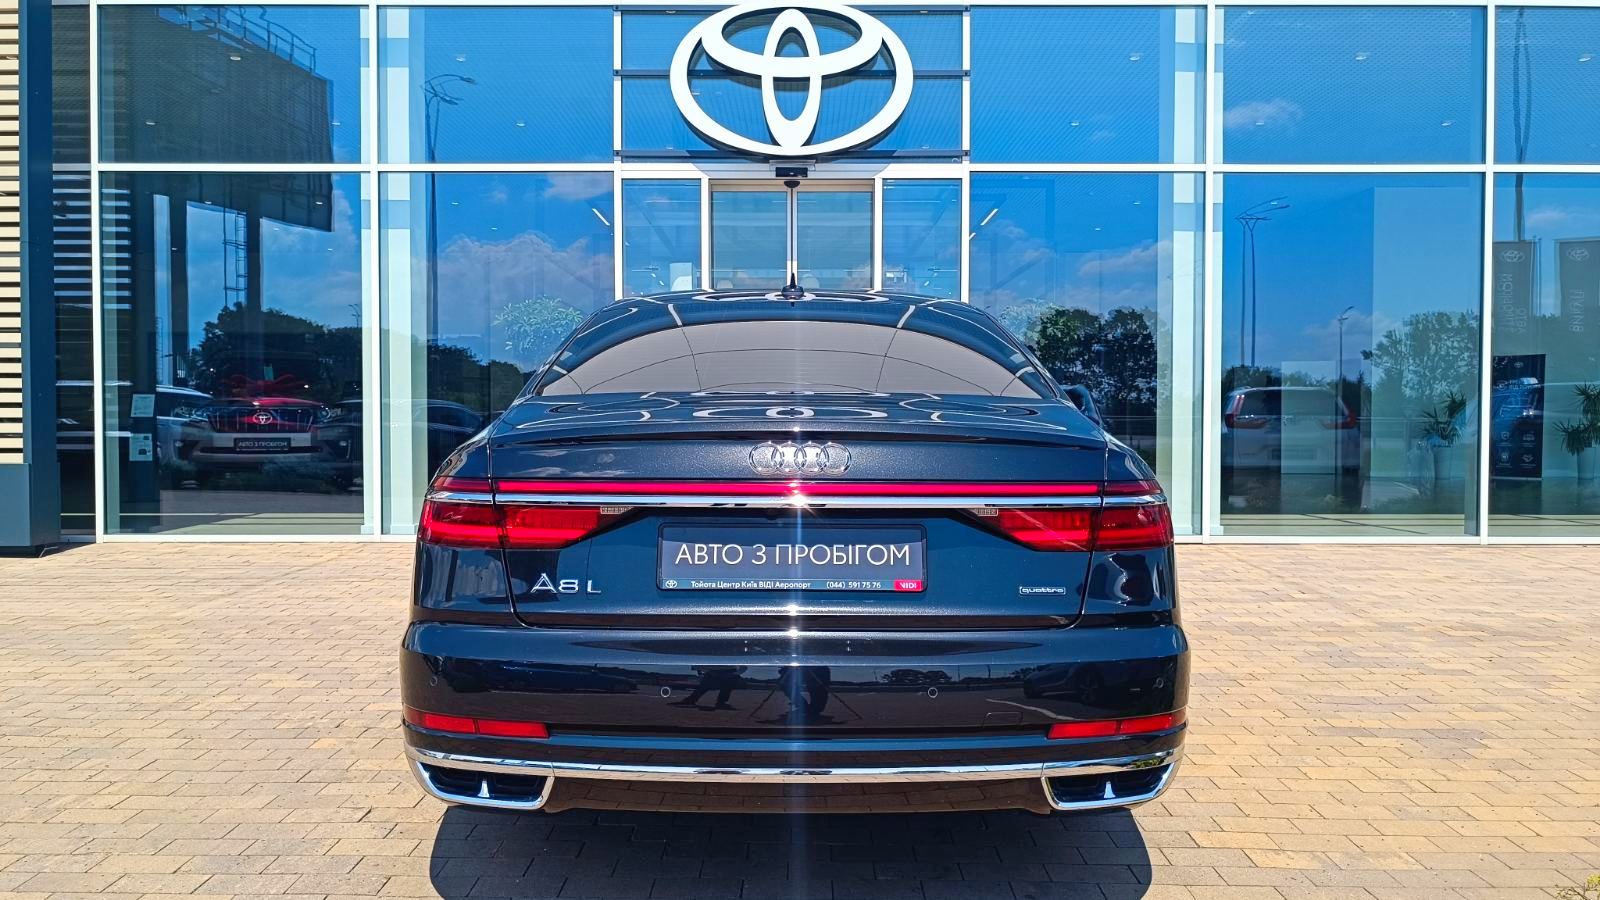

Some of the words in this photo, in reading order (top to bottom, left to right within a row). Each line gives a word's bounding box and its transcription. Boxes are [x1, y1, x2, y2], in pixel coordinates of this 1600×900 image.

[675, 543, 743, 565] АВТО
[751, 543, 767, 565] З
[775, 543, 910, 565] ПРОБІГОМ
[691, 580, 716, 588] Тойота
[717, 580, 740, 589] Центр
[741, 580, 758, 588] Київ
[759, 581, 774, 589] ВІДІ
[775, 581, 811, 589] Аеропорт
[826, 581, 846, 589] (044)
[848, 581, 860, 589] 591
[862, 581, 871, 589] 75
[872, 581, 881, 589] 76
[1022, 586, 1064, 594] quattro
